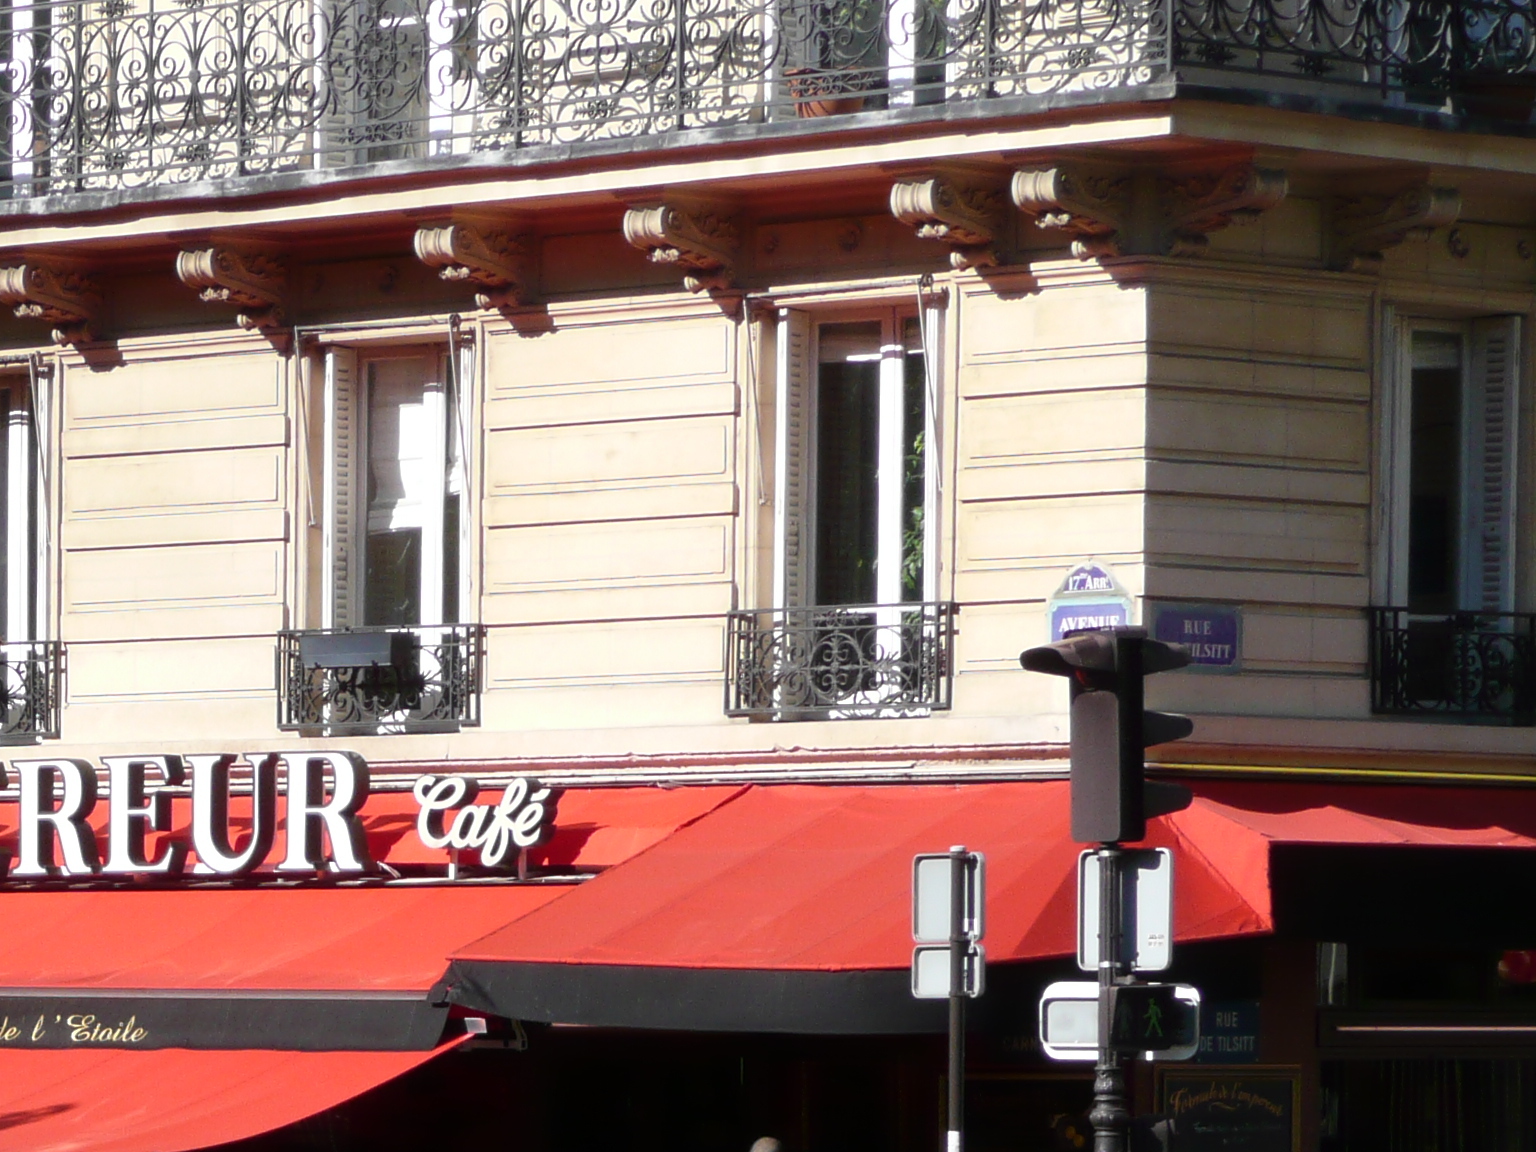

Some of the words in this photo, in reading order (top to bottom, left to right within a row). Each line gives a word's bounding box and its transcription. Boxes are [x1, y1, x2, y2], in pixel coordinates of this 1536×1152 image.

[1058, 615, 1120, 633] AVENUE
[1183, 619, 1212, 635] RUE
[413, 775, 551, 867] Café
[1215, 1011, 1239, 1027] RUE
[1200, 1035, 1213, 1052] DE
[1218, 1035, 1255, 1052] TILSITT
